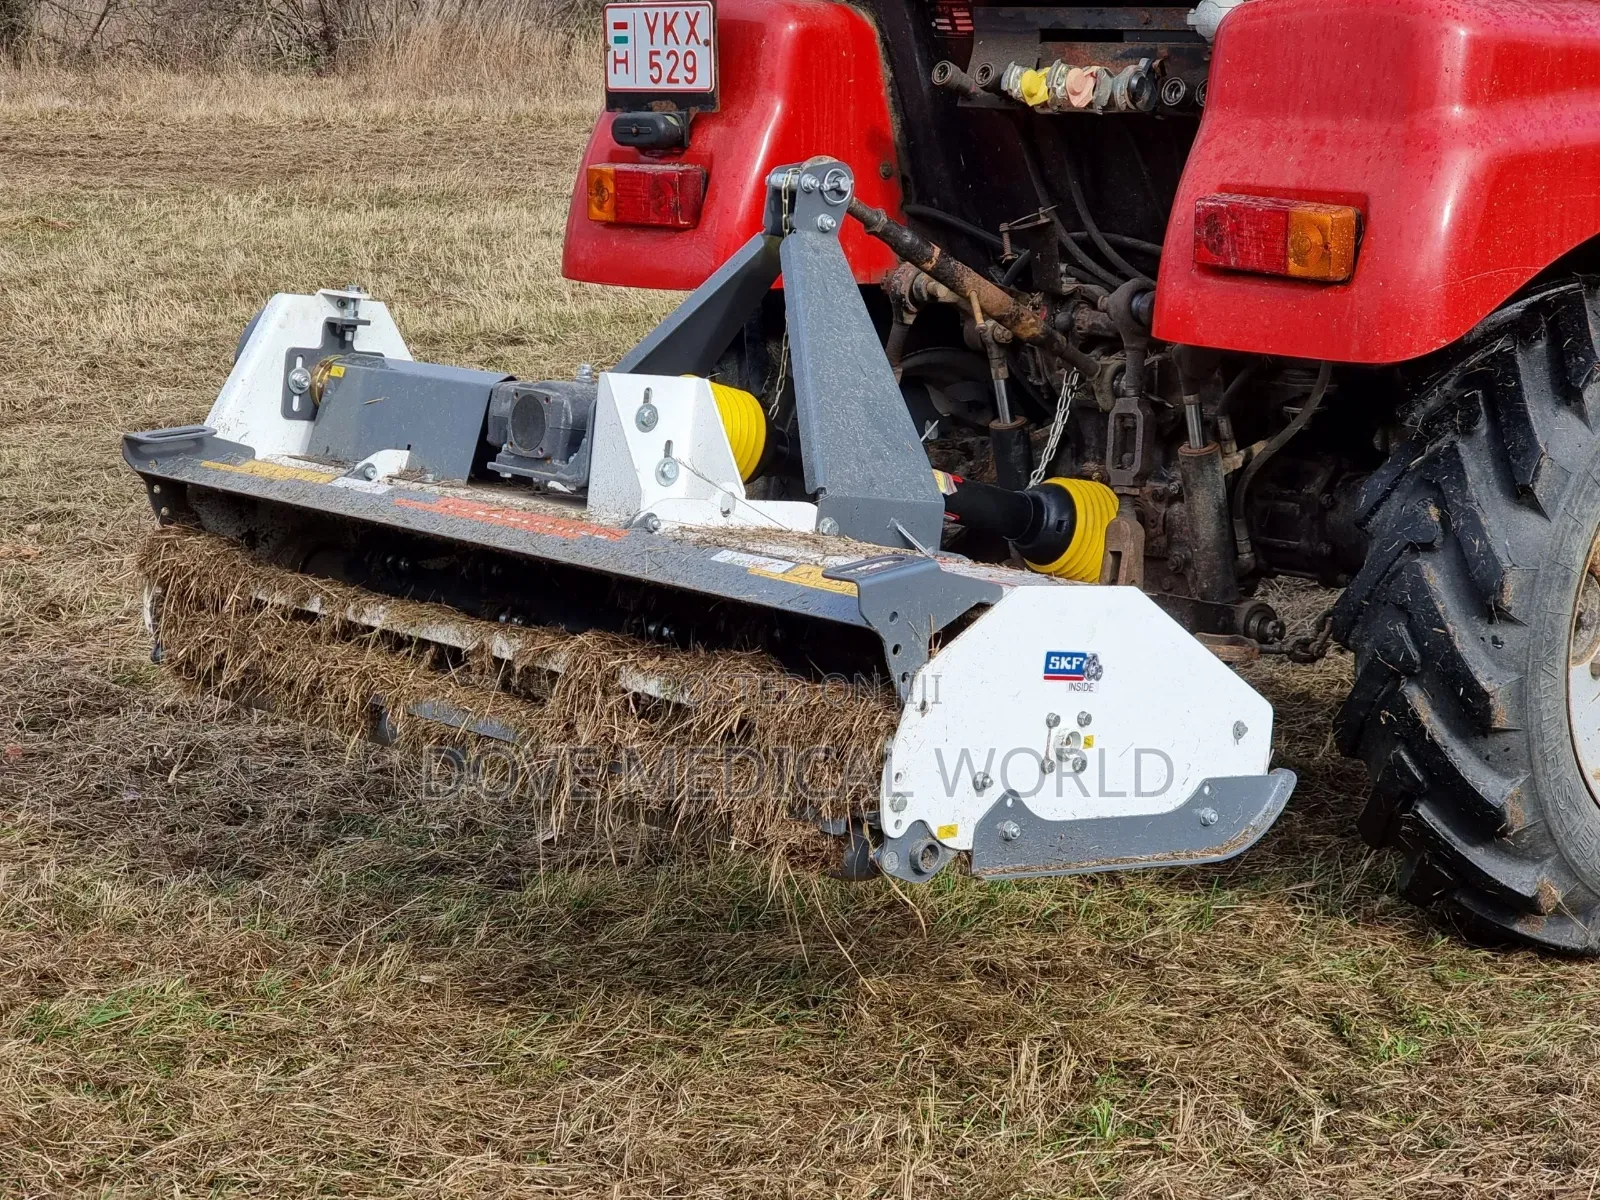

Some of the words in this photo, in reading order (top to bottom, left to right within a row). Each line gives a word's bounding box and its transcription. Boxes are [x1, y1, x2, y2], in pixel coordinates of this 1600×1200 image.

[644, 11, 701, 46] YKX
[613, 50, 629, 75] H
[648, 49, 698, 85] 529
[1048, 656, 1084, 670] SKF
[1068, 682, 1095, 692] INSIDE
